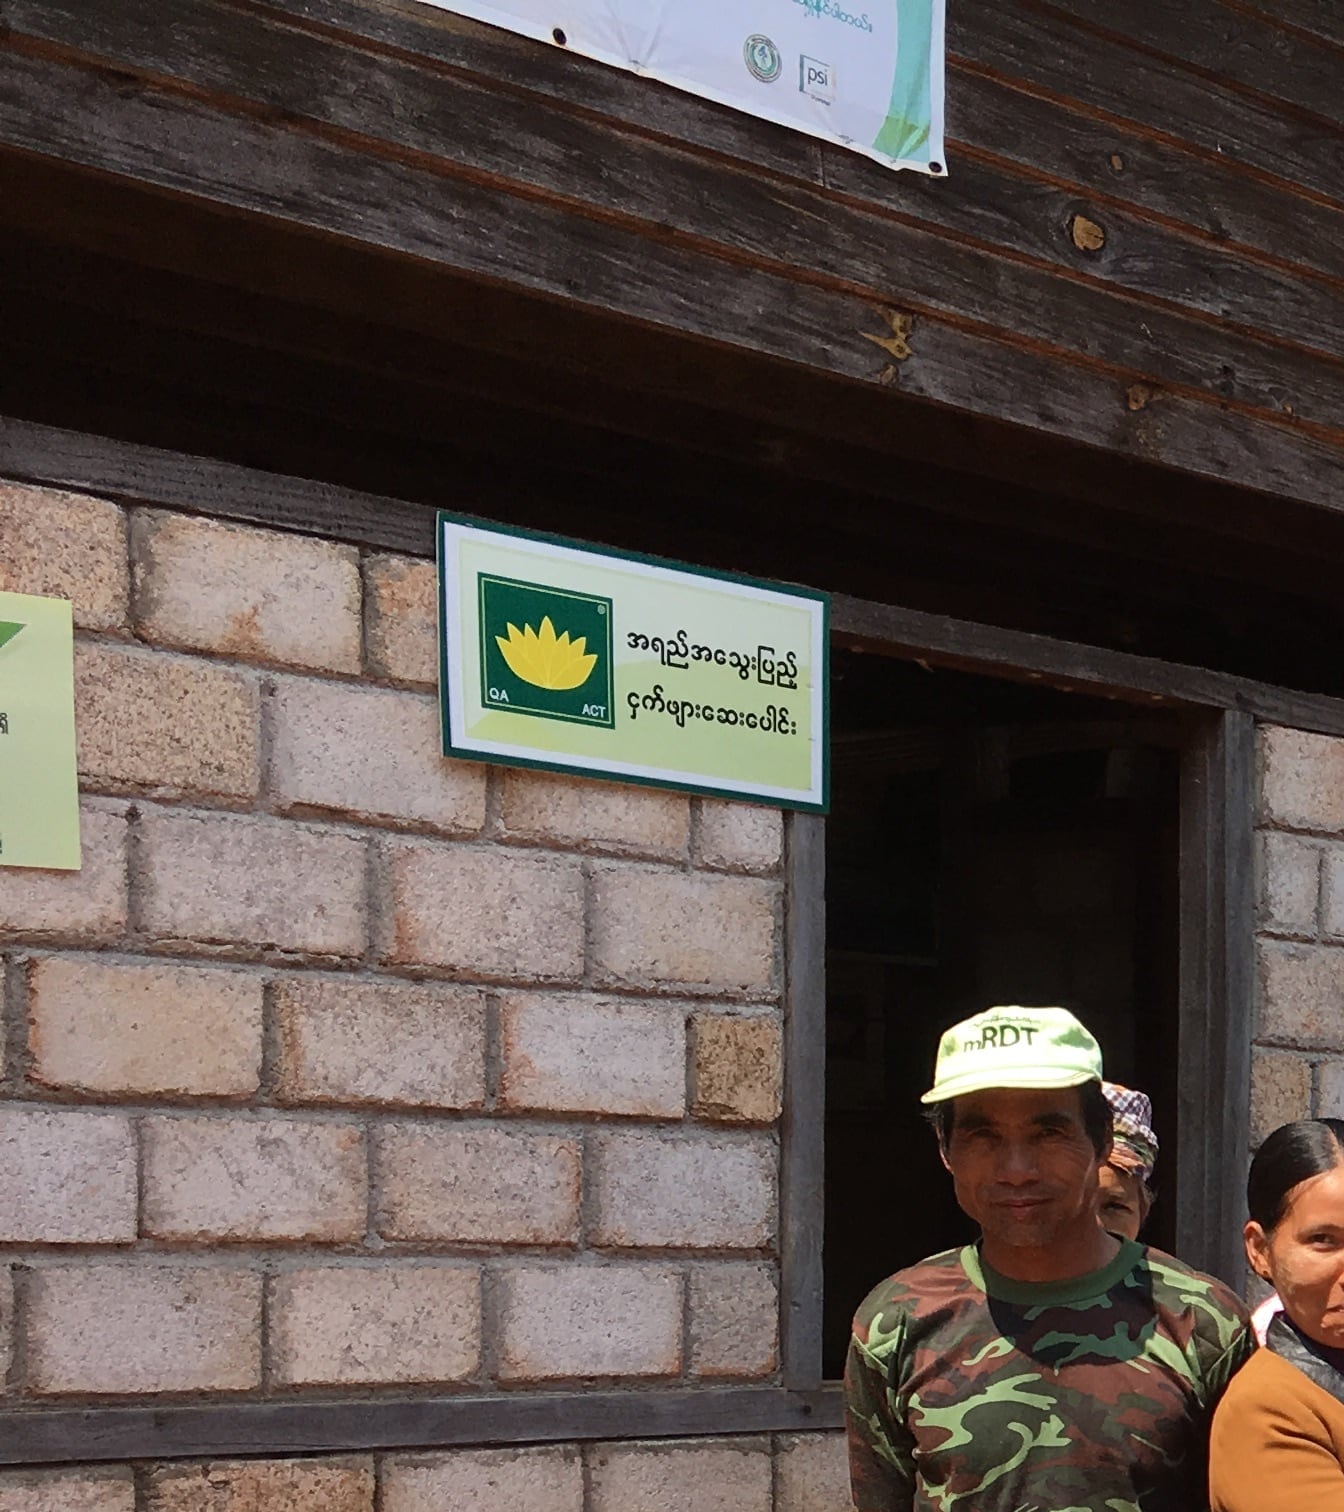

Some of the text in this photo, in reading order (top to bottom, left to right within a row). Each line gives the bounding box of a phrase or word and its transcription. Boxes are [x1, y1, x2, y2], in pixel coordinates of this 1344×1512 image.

[807, 67, 828, 86] psi
[627, 629, 798, 689] အရည်အသွေးပြည့်
[489, 687, 510, 702] QA
[582, 703, 606, 719] ACT
[627, 684, 797, 736] ငှက်ဖျားဆေးပေါင်း
[964, 1024, 1039, 1052] mRDT
